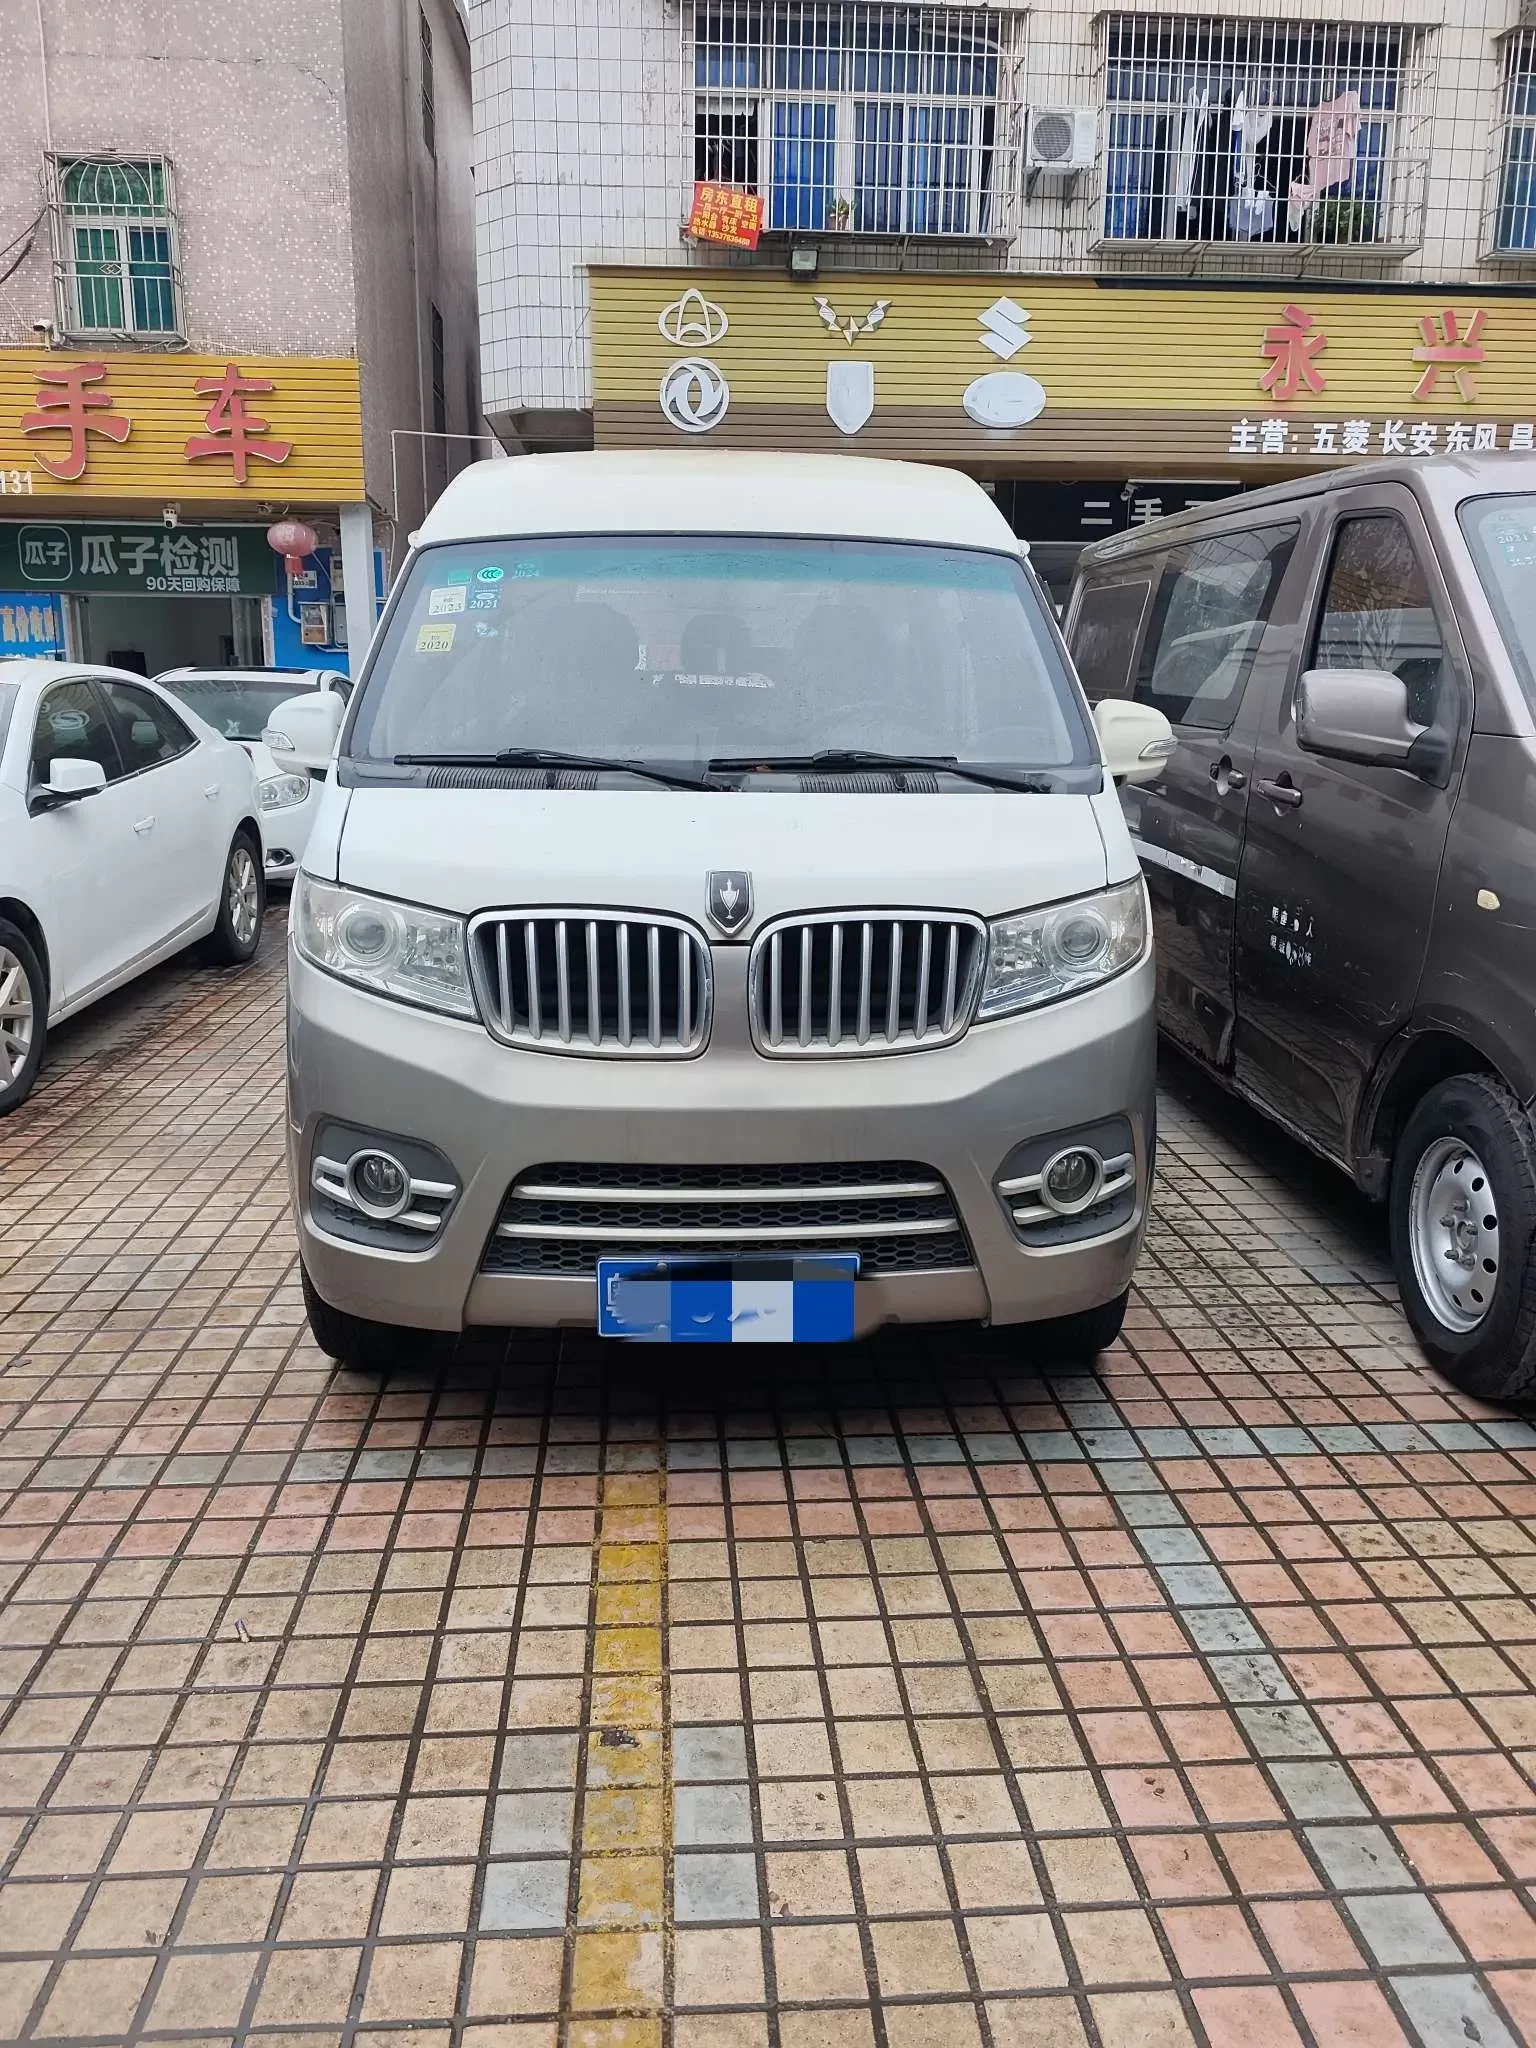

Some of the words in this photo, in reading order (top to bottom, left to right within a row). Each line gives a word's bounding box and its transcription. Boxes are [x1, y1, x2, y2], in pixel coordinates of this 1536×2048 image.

[700, 187, 758, 213] 房东直租
[1258, 304, 1488, 403] 永兴
[1310, 419, 1371, 454] 五菱
[1379, 419, 1438, 455] 长安
[1444, 421, 1500, 454] 东风
[25, 541, 68, 566] 瓜子
[79, 535, 241, 577] 瓜子检测
[146, 576, 241, 593] 90天回购保障
[419, 641, 449, 651] 2020
